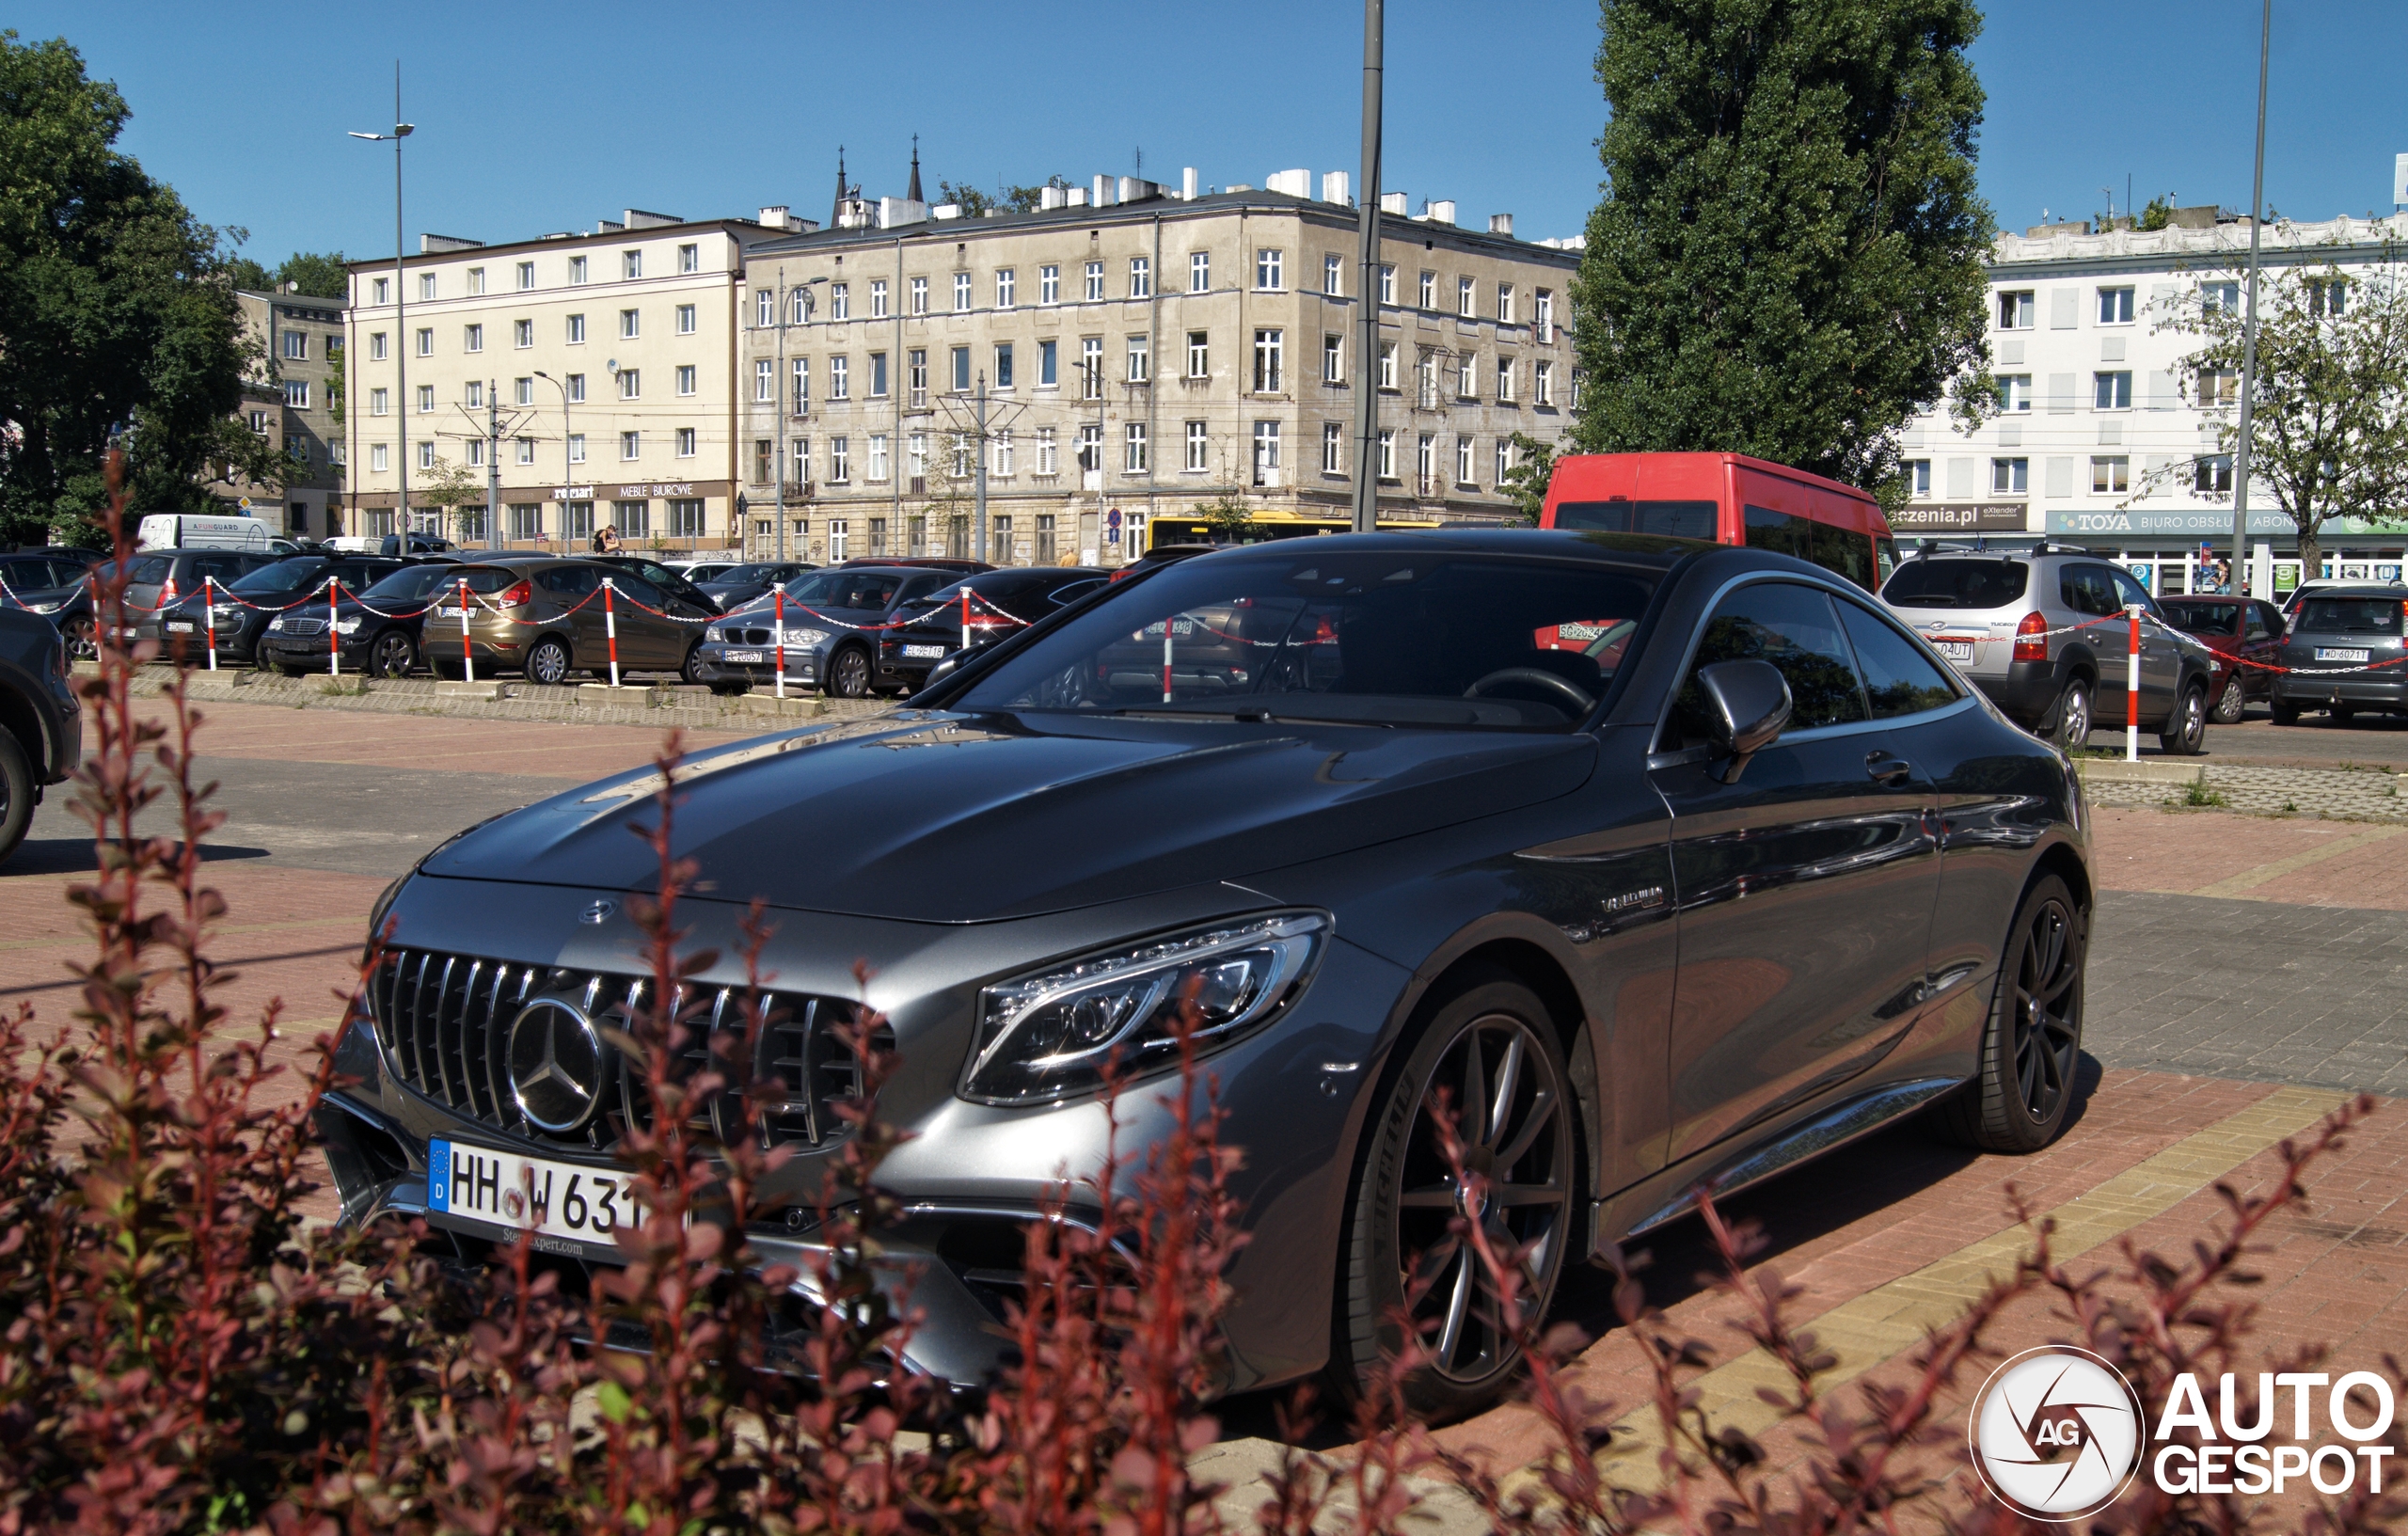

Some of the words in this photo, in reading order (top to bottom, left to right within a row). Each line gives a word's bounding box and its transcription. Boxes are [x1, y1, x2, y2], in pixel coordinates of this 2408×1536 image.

[621, 485, 647, 498] MEBLE
[653, 483, 693, 497] BIUROWE
[2078, 515, 2131, 530] TOYA
[2141, 516, 2183, 528] BIURO
[2187, 515, 2248, 529] OBSŁUI
[2324, 650, 2337, 658] WD
[2338, 650, 2366, 659] 6071T
[1374, 1078, 1413, 1242] MICHELIN
[452, 1150, 499, 1214] HH
[527, 1165, 553, 1225] W
